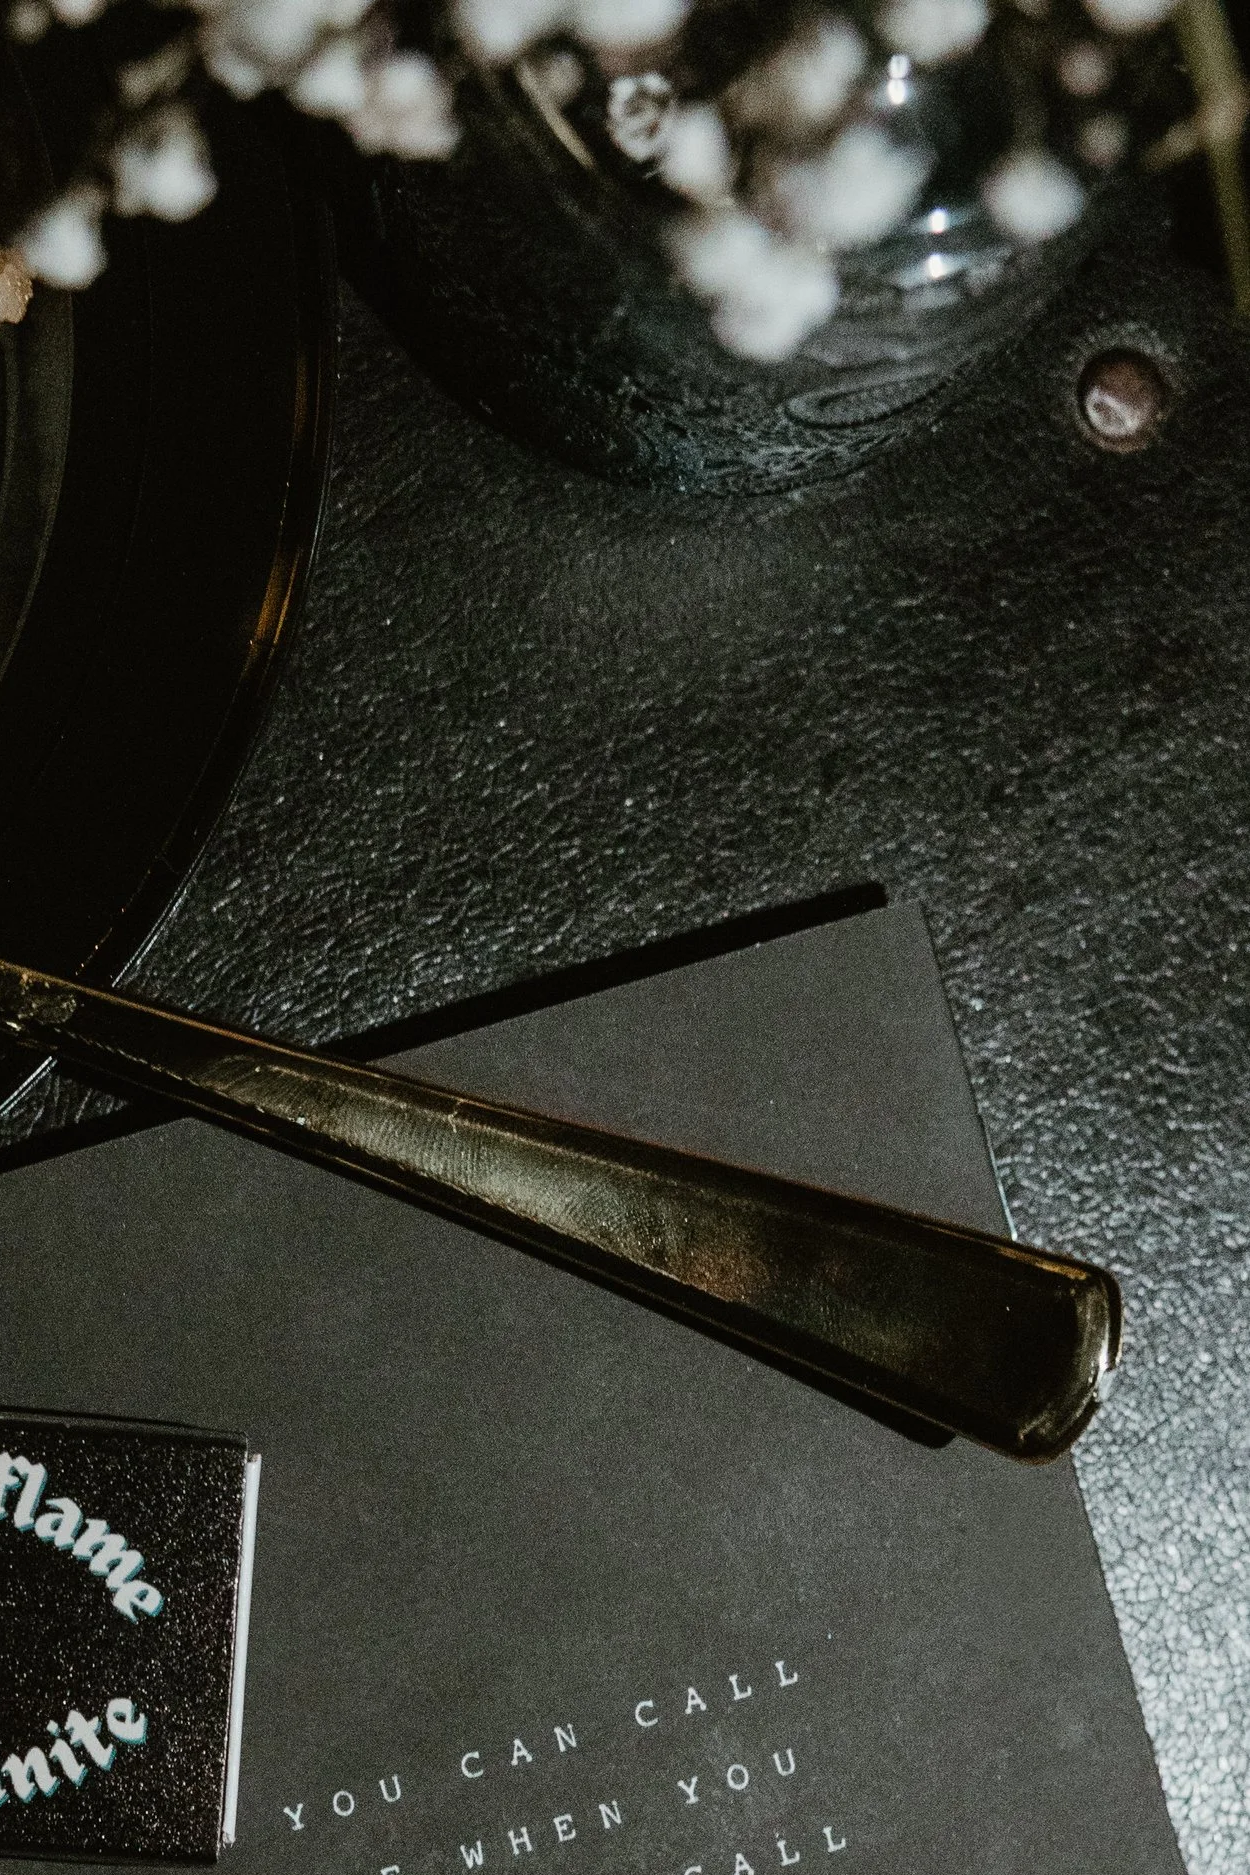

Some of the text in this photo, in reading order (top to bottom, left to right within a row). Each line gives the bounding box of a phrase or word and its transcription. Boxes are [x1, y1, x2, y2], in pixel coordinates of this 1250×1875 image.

[283, 1658, 799, 1832] YOU CAN CALL
[460, 1800, 624, 1871] WHEN
[677, 1748, 796, 1806] YOU
